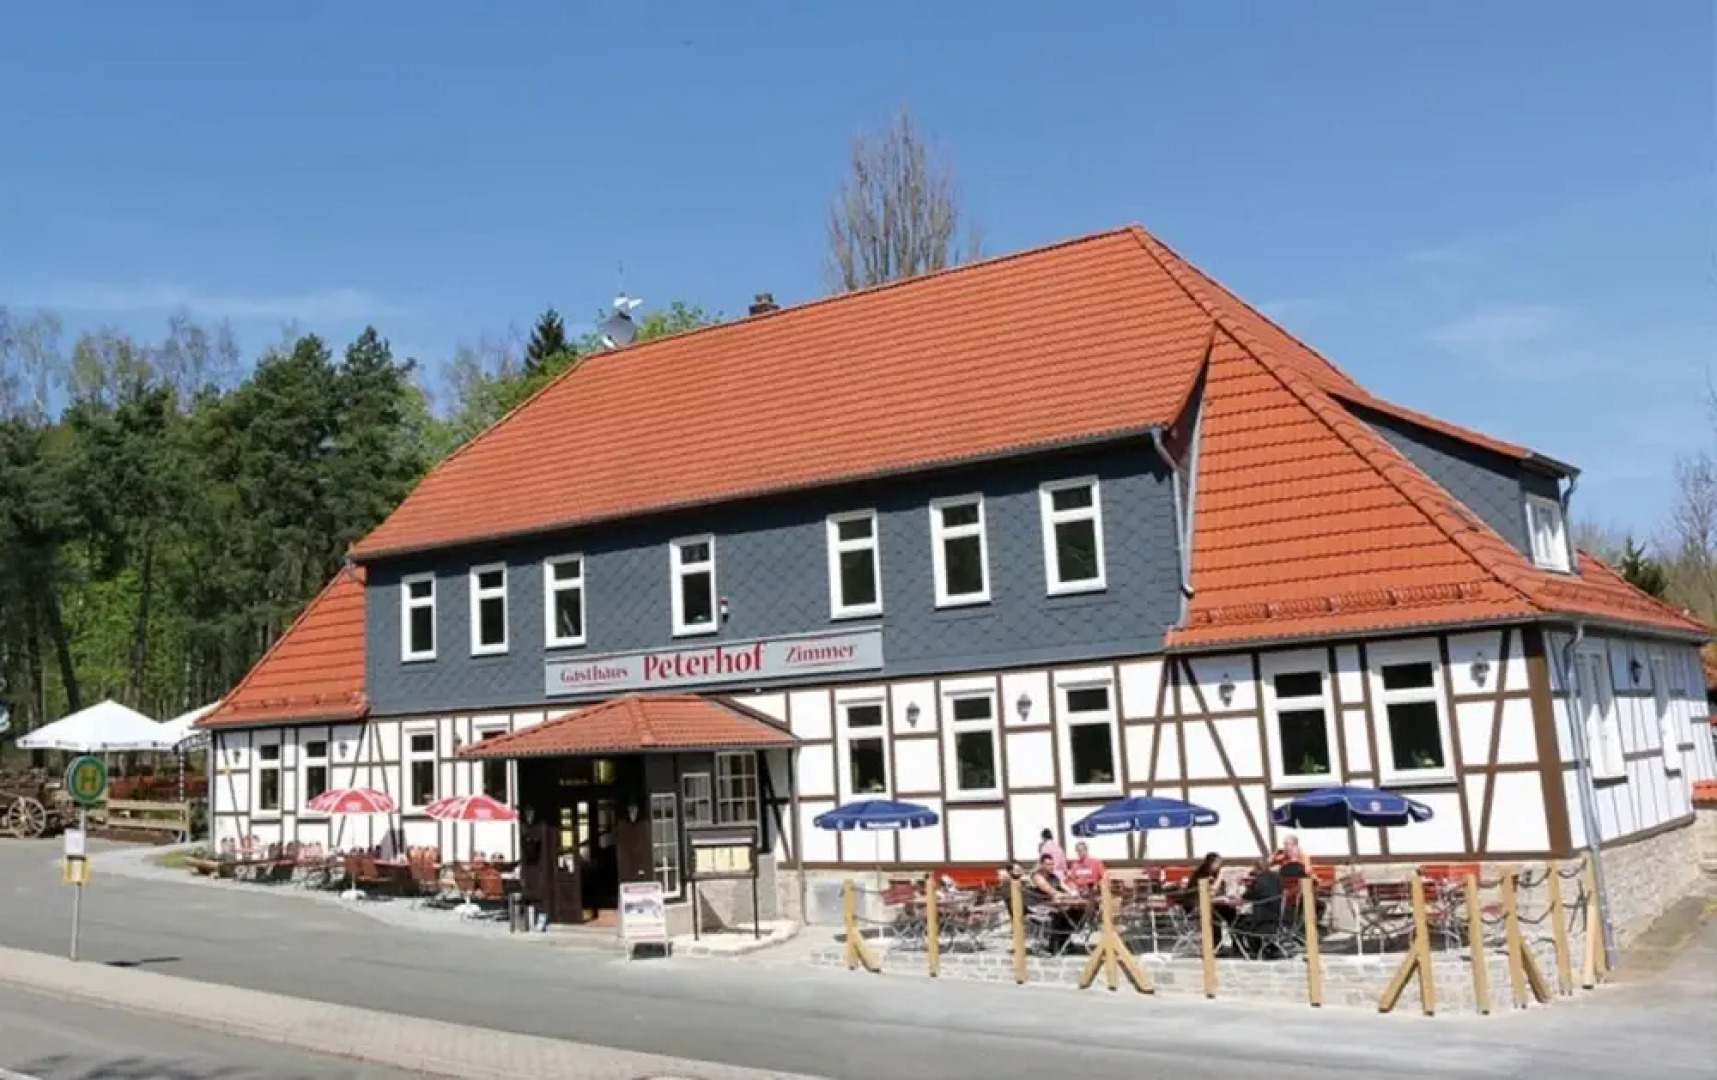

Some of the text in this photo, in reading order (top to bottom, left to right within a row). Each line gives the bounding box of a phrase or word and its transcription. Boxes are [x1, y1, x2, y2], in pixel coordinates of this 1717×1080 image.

[560, 641, 858, 684] Gasthaus Peterhof Zimmer
[79, 765, 99, 792] H
